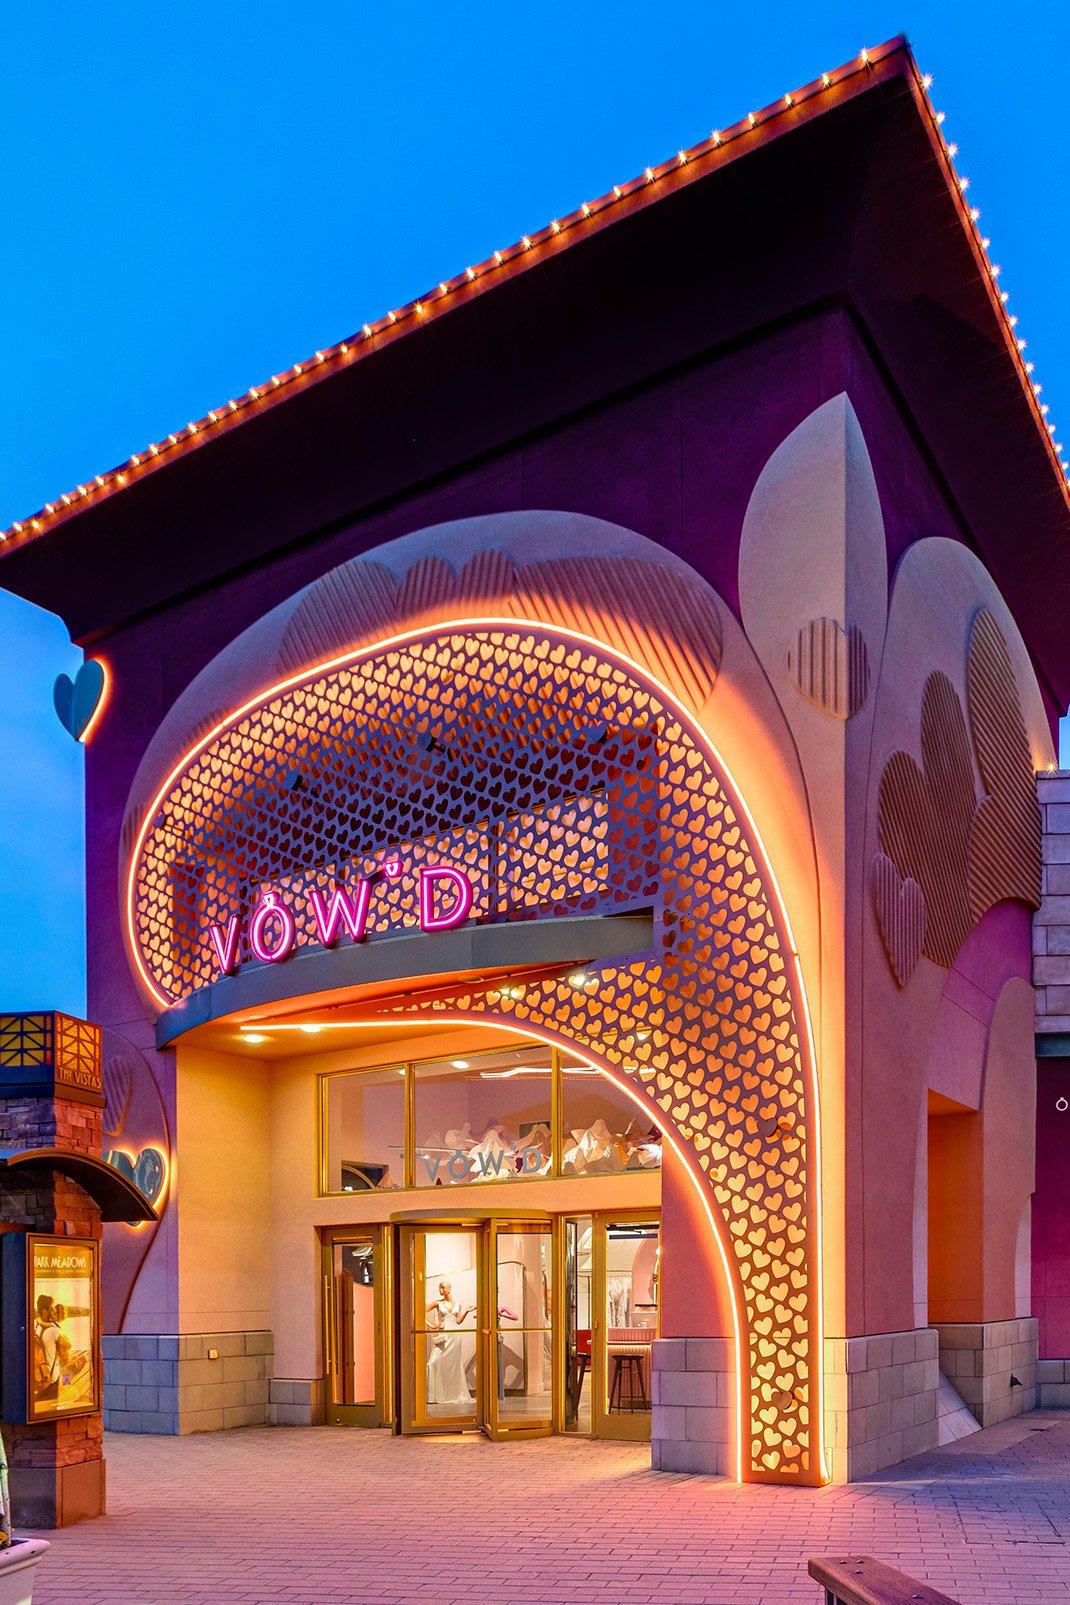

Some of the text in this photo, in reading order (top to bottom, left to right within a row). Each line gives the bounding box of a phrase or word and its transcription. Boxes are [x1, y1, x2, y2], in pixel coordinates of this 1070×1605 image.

[58, 1066, 102, 1089] THE VISTAS
[33, 1255, 87, 1269] PARK MEADOWS
